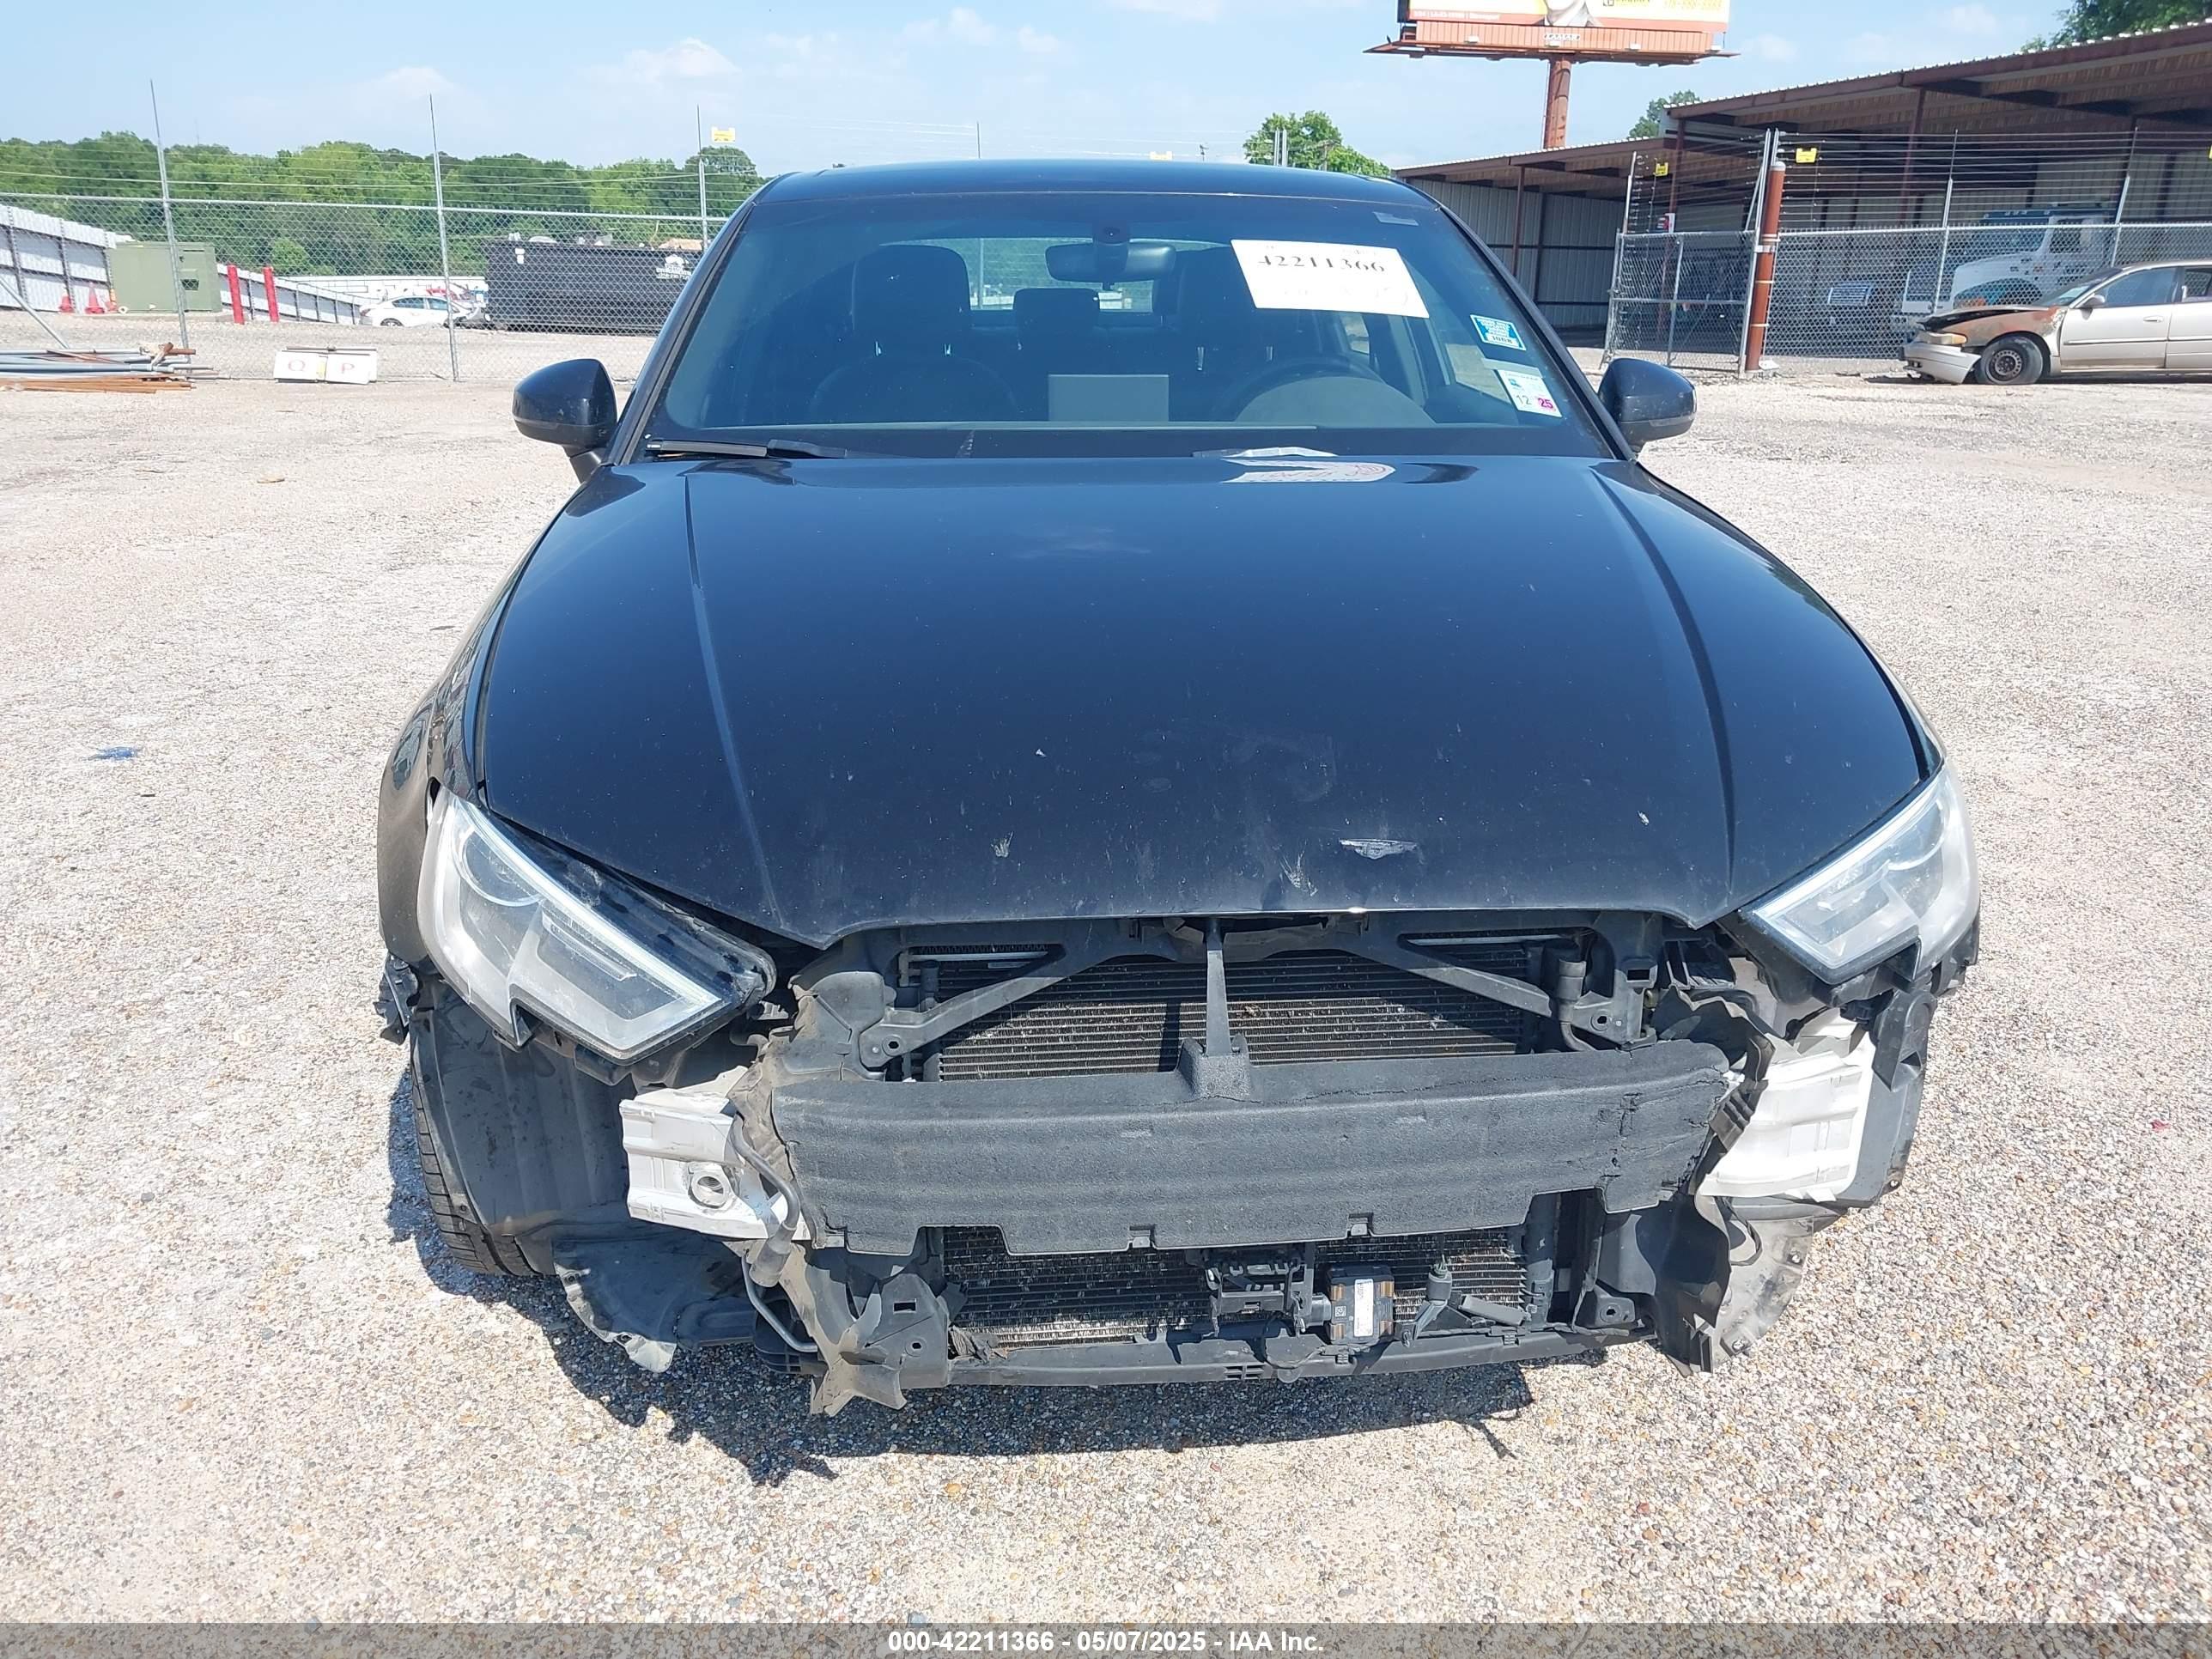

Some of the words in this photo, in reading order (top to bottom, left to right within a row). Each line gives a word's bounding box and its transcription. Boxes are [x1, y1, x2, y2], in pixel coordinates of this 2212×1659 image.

[1258, 255, 1385, 272] 42211366
[341, 362, 355, 374] P
[1516, 395, 1532, 405] 12
[1537, 398, 1553, 410] 25
